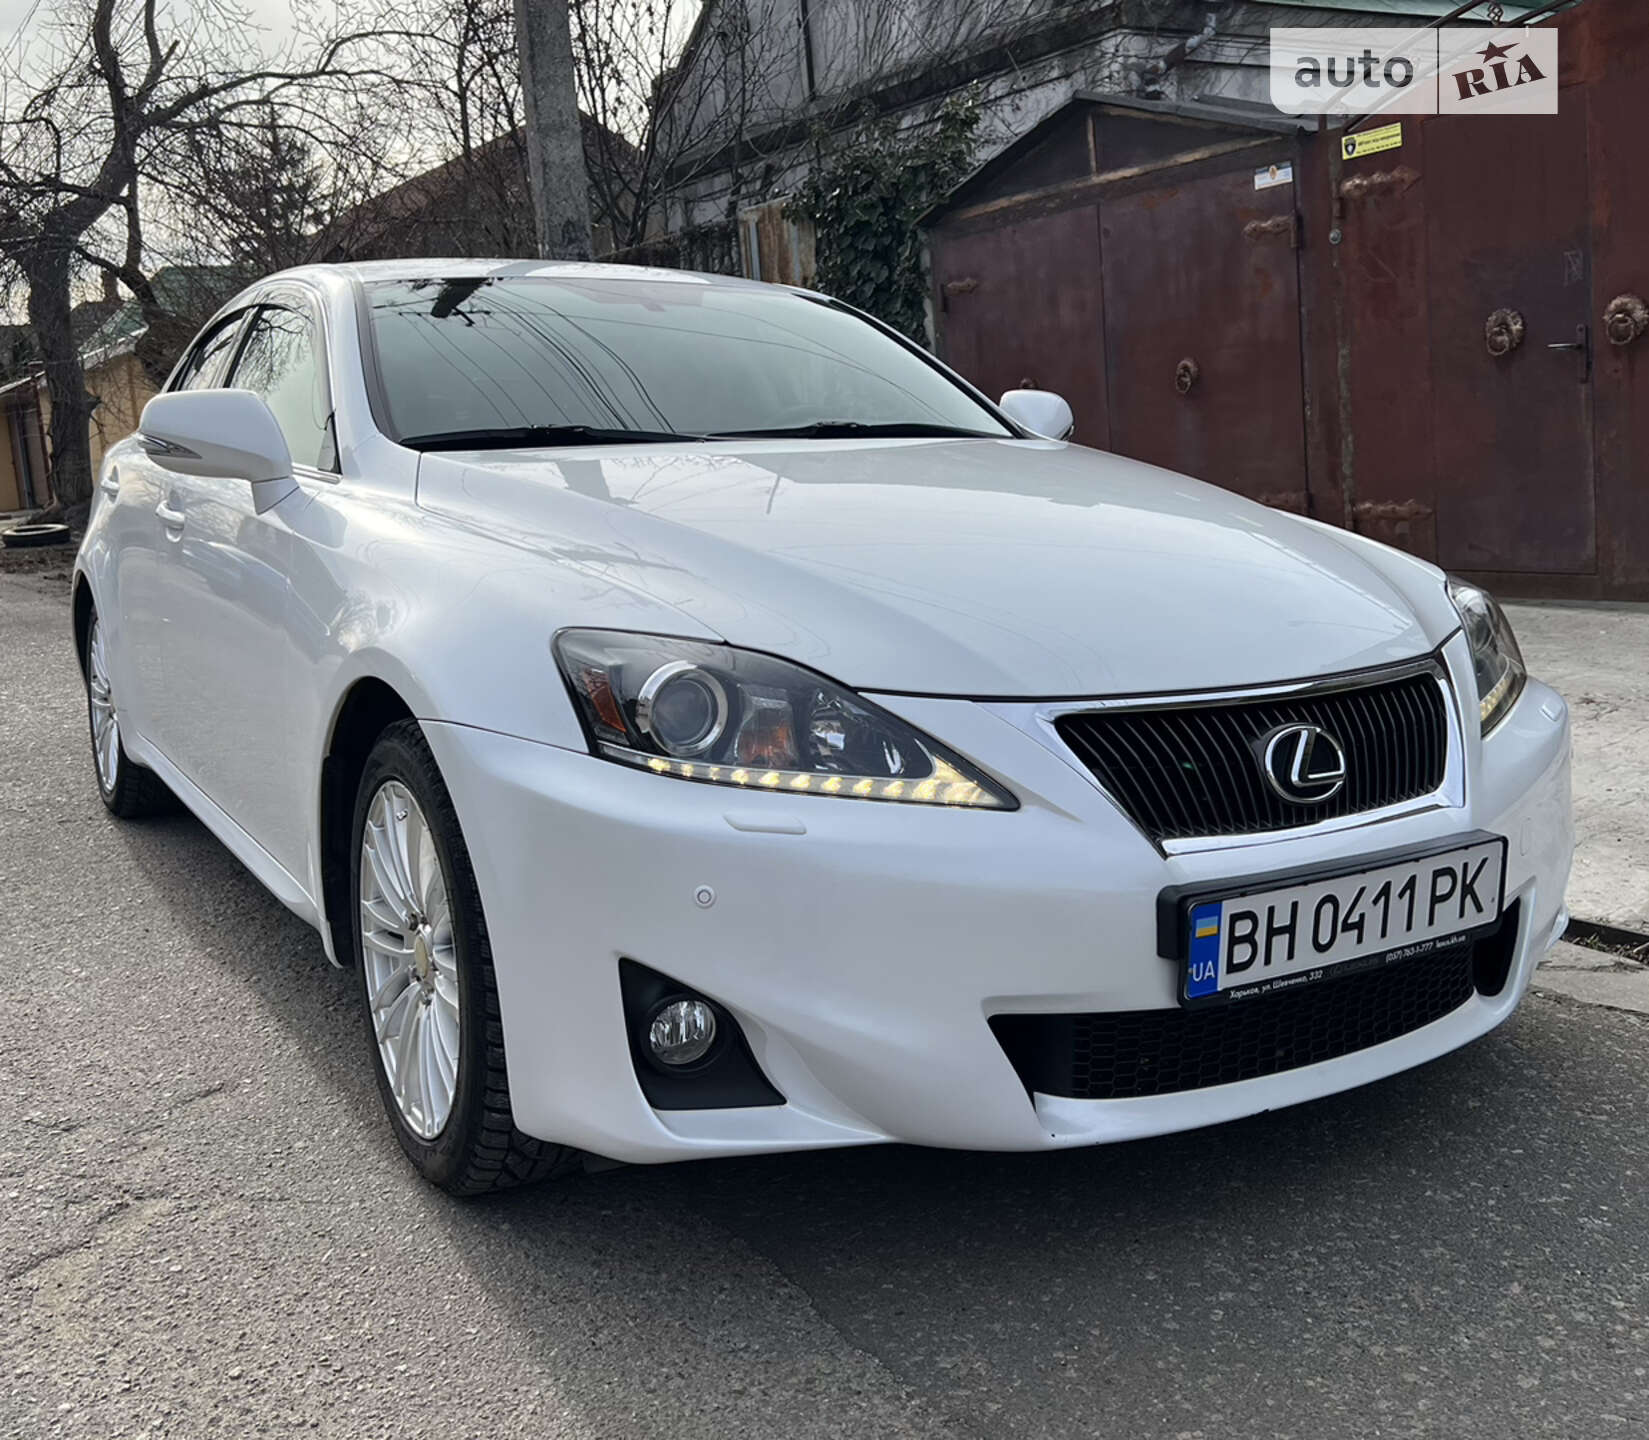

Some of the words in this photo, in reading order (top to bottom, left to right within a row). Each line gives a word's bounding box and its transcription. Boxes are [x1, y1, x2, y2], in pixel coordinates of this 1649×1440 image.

[1226, 900, 1299, 975] BH
[1311, 873, 1417, 953] 0411
[1427, 856, 1489, 928] PK
[1192, 959, 1216, 982] UA
